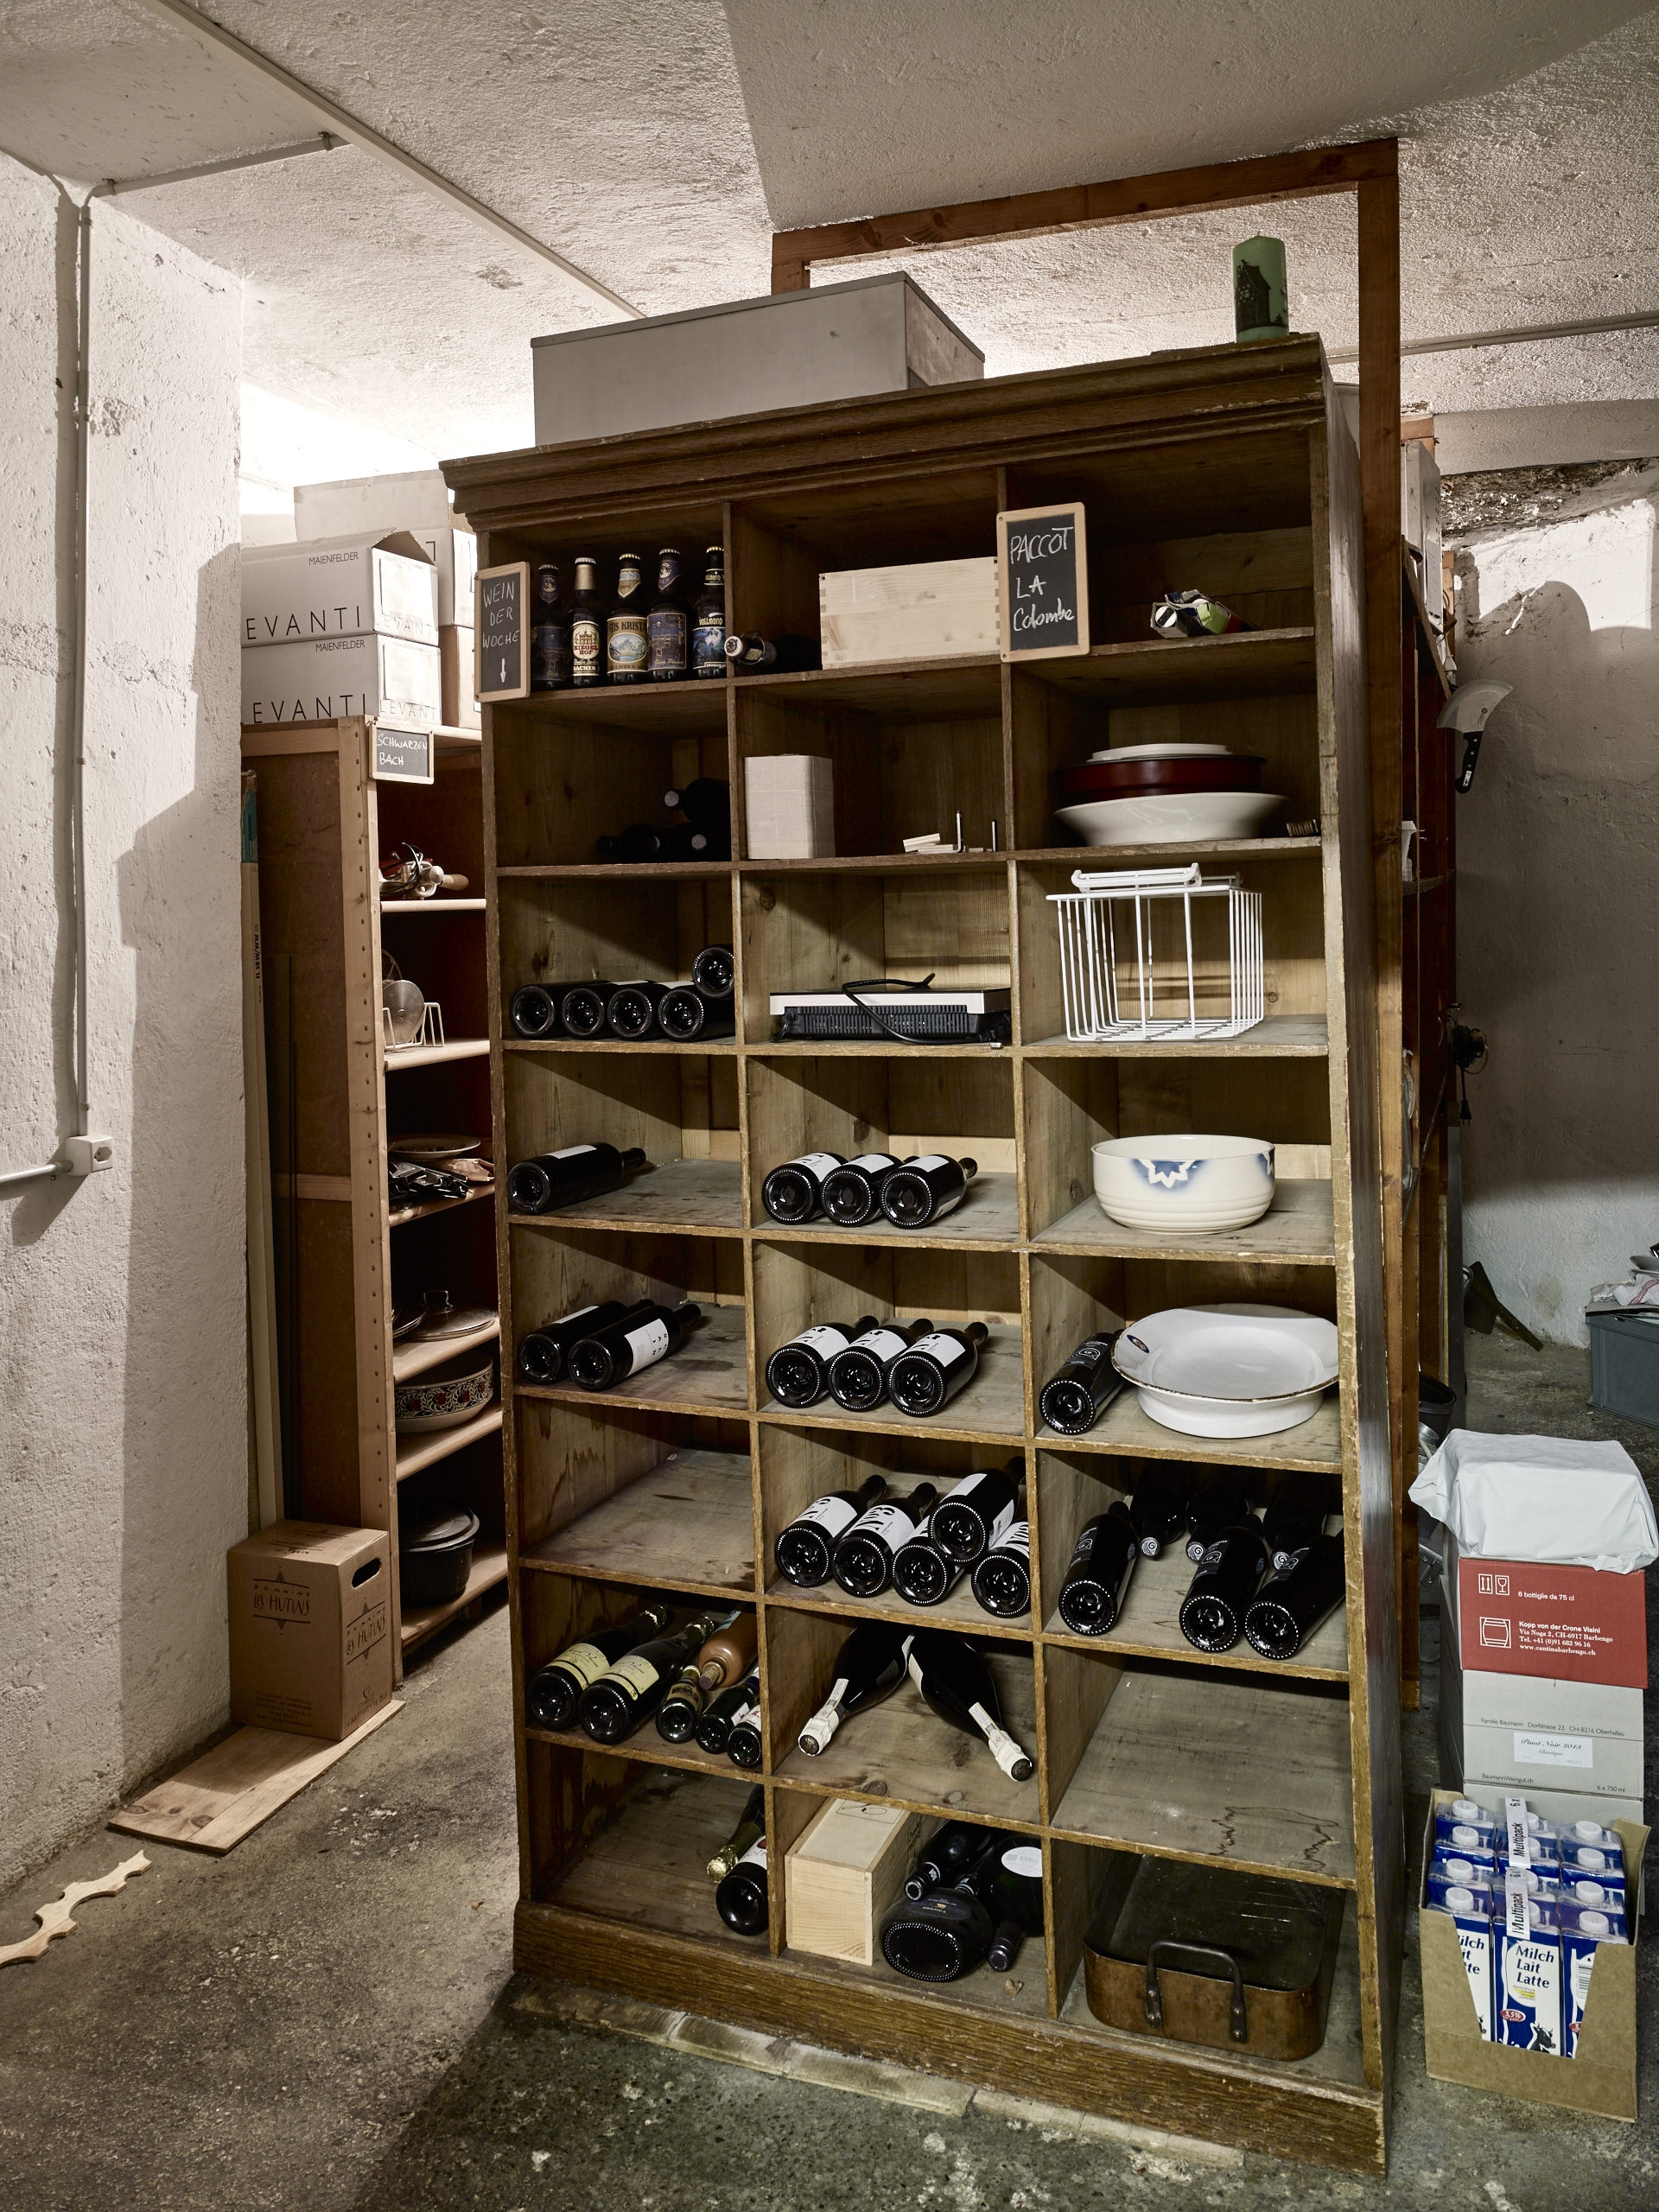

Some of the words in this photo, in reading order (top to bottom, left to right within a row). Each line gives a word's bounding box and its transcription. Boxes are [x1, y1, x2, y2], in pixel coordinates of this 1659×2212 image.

[1010, 526, 1074, 564] PACCOT
[308, 551, 359, 566] MAIENFELDER
[482, 581, 515, 607] WEIN
[1016, 575, 1046, 599] LA
[246, 606, 360, 640] EVANTI
[490, 607, 513, 626] DER
[1013, 598, 1075, 632] Colombe
[315, 639, 365, 653] MAIENFELDER
[482, 629, 520, 649] WOCHE
[252, 693, 366, 724] EVANTI
[377, 734, 428, 752] SCHWARZEN
[378, 751, 404, 766] BACH
[1523, 1591, 1548, 1601] bottiglie
[1518, 1620, 1536, 1630] Kopp
[1583, 1625, 1601, 1634] Visini
[1530, 1629, 1547, 1637] Noga
[1554, 1631, 1582, 1640] CH-6917
[1583, 1633, 1613, 1643] Barbengo
[1519, 1644, 1596, 1656] www.cantinabarbengo.ch
[1499, 1719, 1523, 1727] Baumann
[1528, 1721, 1556, 1730] Dorfstrasse
[1568, 1726, 1595, 1734] CH-8216
[1596, 1728, 1625, 1737] Oberhallau
[1482, 1773, 1535, 1784] BaumannWeingut.ch
[1511, 1822, 1525, 1858] Multipack
[1510, 1892, 1524, 1935] Multipack
[1462, 1948, 1471, 1961] it
[1516, 1945, 1554, 1963] Milch
[1516, 1958, 1541, 1974] Lait
[1516, 1972, 1549, 1988] Latte
